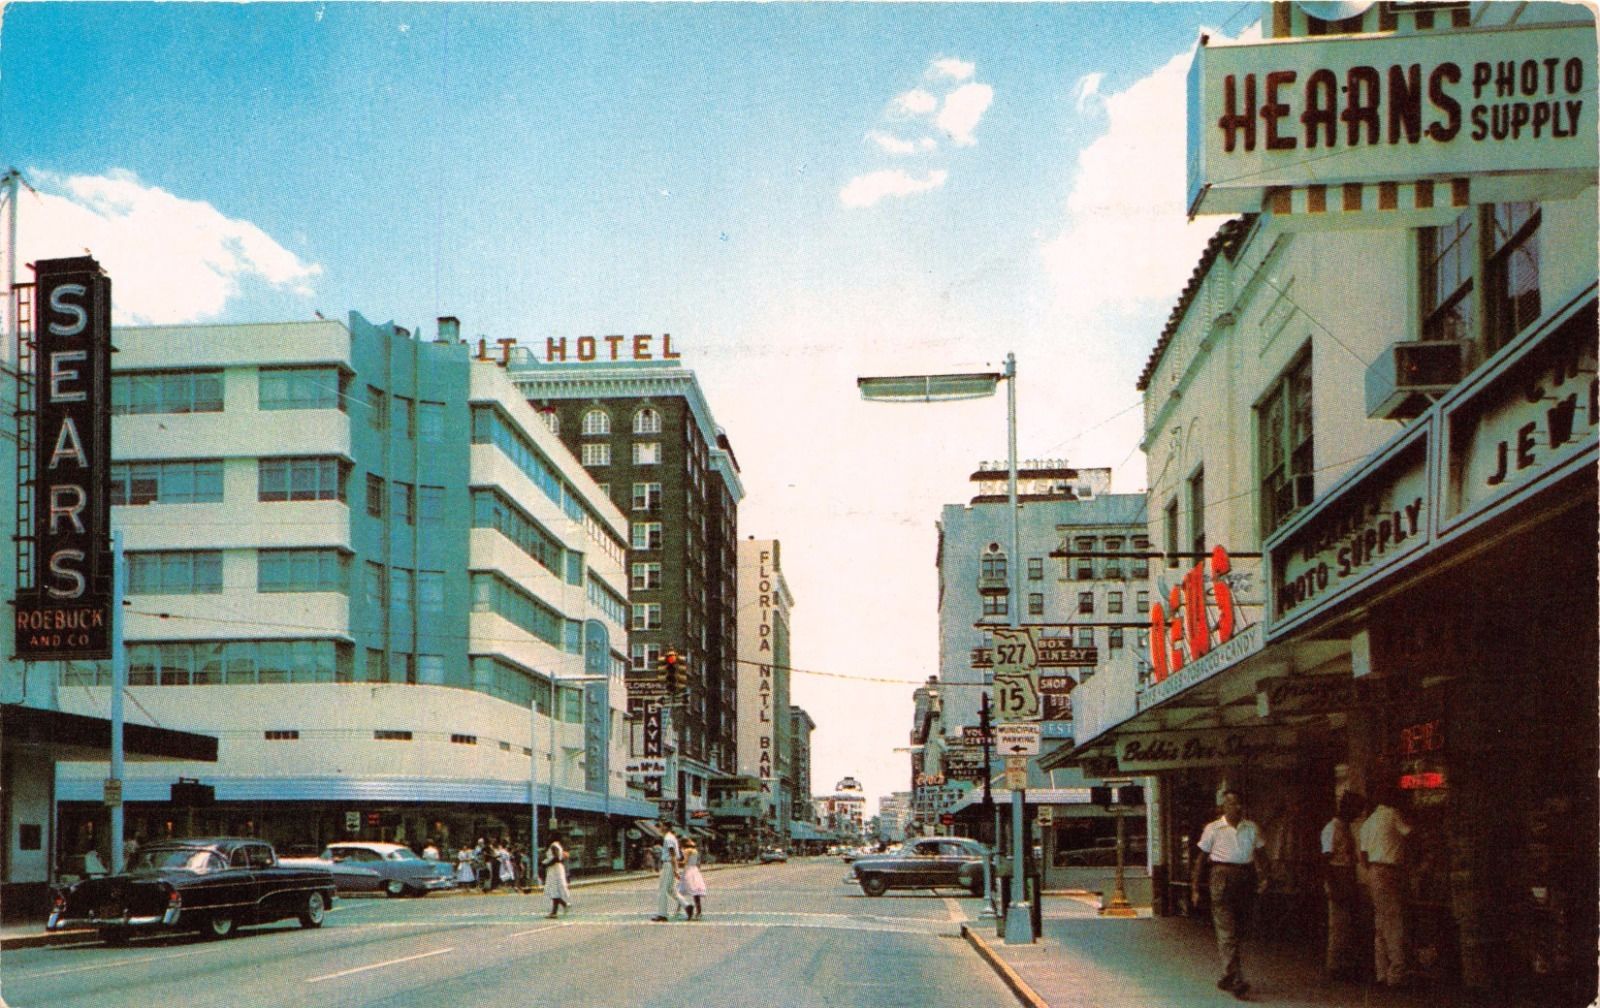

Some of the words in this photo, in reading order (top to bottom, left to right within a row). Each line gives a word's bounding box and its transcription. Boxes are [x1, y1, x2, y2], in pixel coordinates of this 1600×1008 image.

[1471, 57, 1584, 99] PHOTO
[1218, 62, 1462, 153] HEARNS
[1470, 99, 1584, 142] SUPPLY
[546, 333, 681, 362] HOTEL
[48, 283, 89, 600] SEARS
[1336, 497, 1422, 578] SUPPLY
[16, 607, 105, 631] ROEBUCK
[758, 551, 771, 652] FLORIDA
[30, 633, 63, 648] AND
[67, 633, 91, 647] CO
[996, 643, 1027, 665] 527
[999, 687, 1025, 712] 15
[758, 736, 771, 793] BANK
